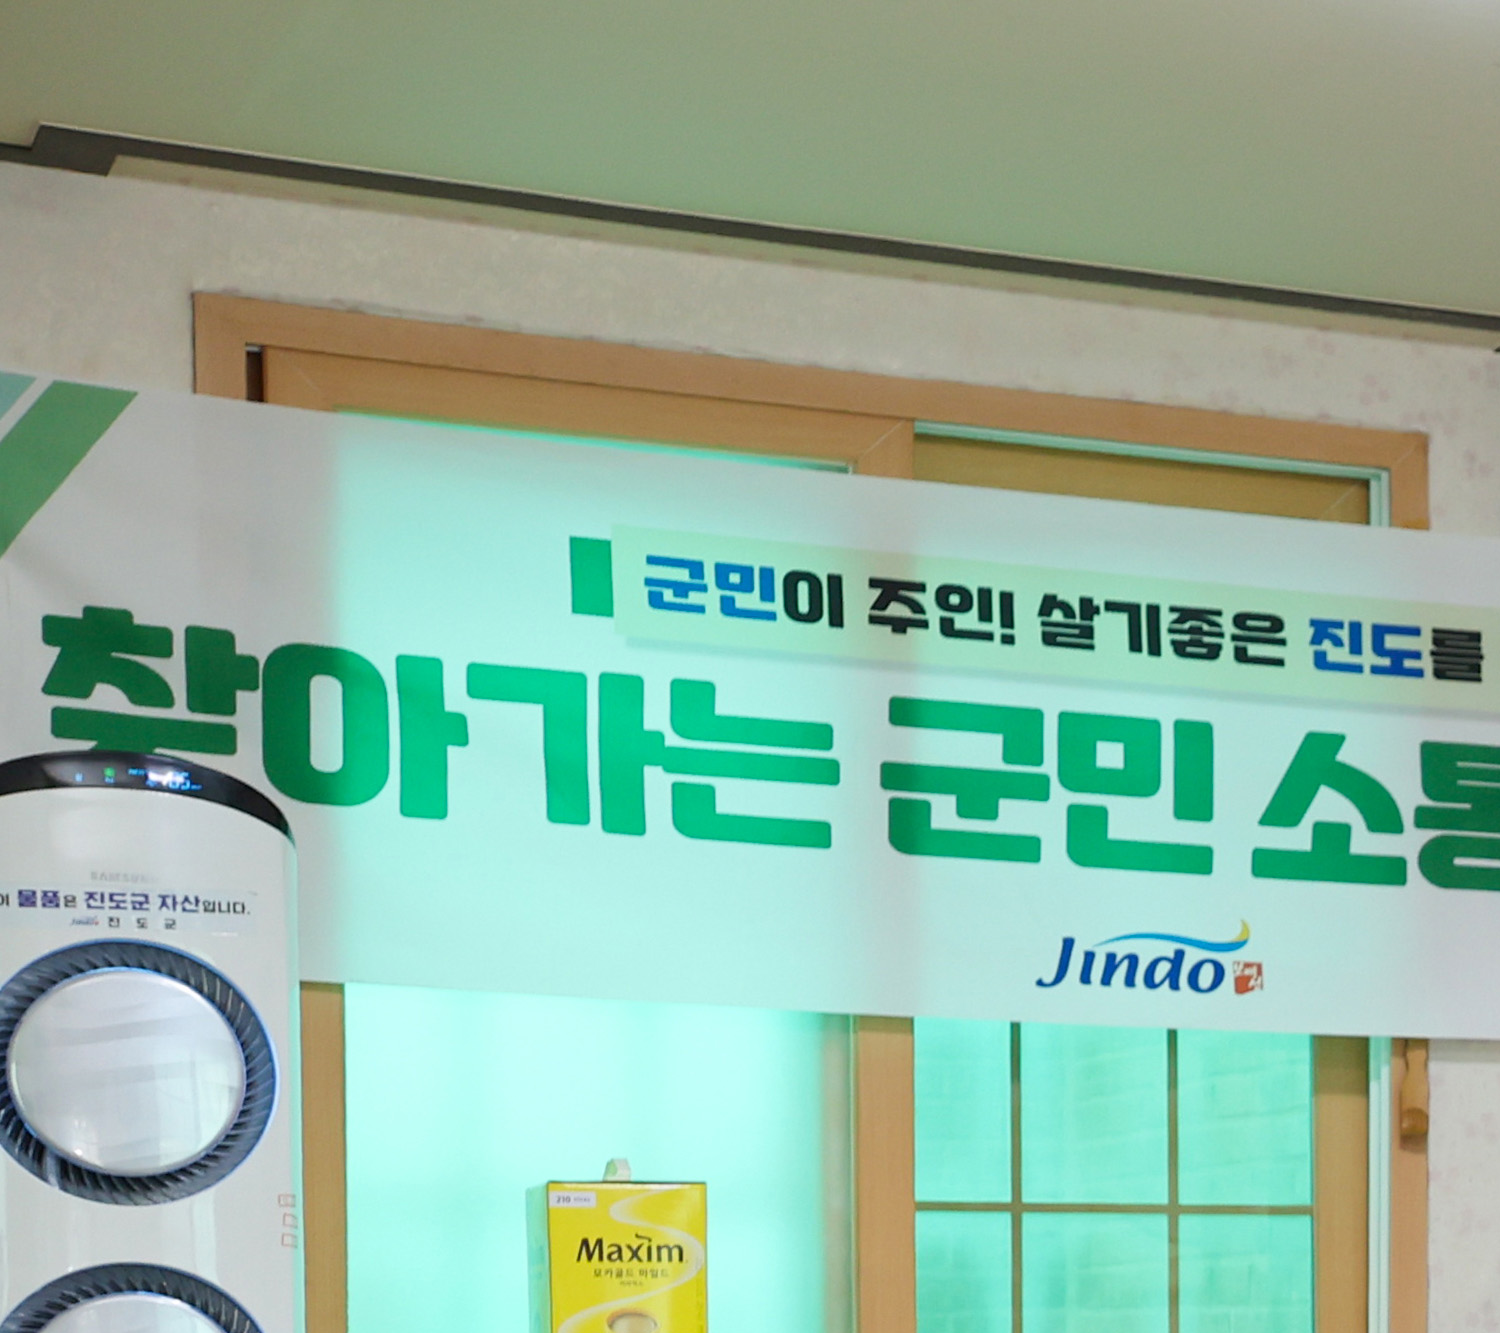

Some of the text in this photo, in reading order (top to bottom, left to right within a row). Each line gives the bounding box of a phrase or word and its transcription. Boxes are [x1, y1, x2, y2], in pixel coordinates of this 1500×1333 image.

[643, 554, 845, 630] 군민이
[866, 574, 1017, 645] 주인!
[1036, 592, 1288, 668] 살기좋은
[1308, 616, 1485, 685] 진도를
[40, 605, 841, 850] 찾아가는
[879, 695, 1214, 876] 군민
[84, 891, 151, 912] 진도군
[157, 893, 251, 915] 자산입니다.
[1034, 938, 1227, 994] Jindo
[576, 1233, 684, 1263] Maxim
